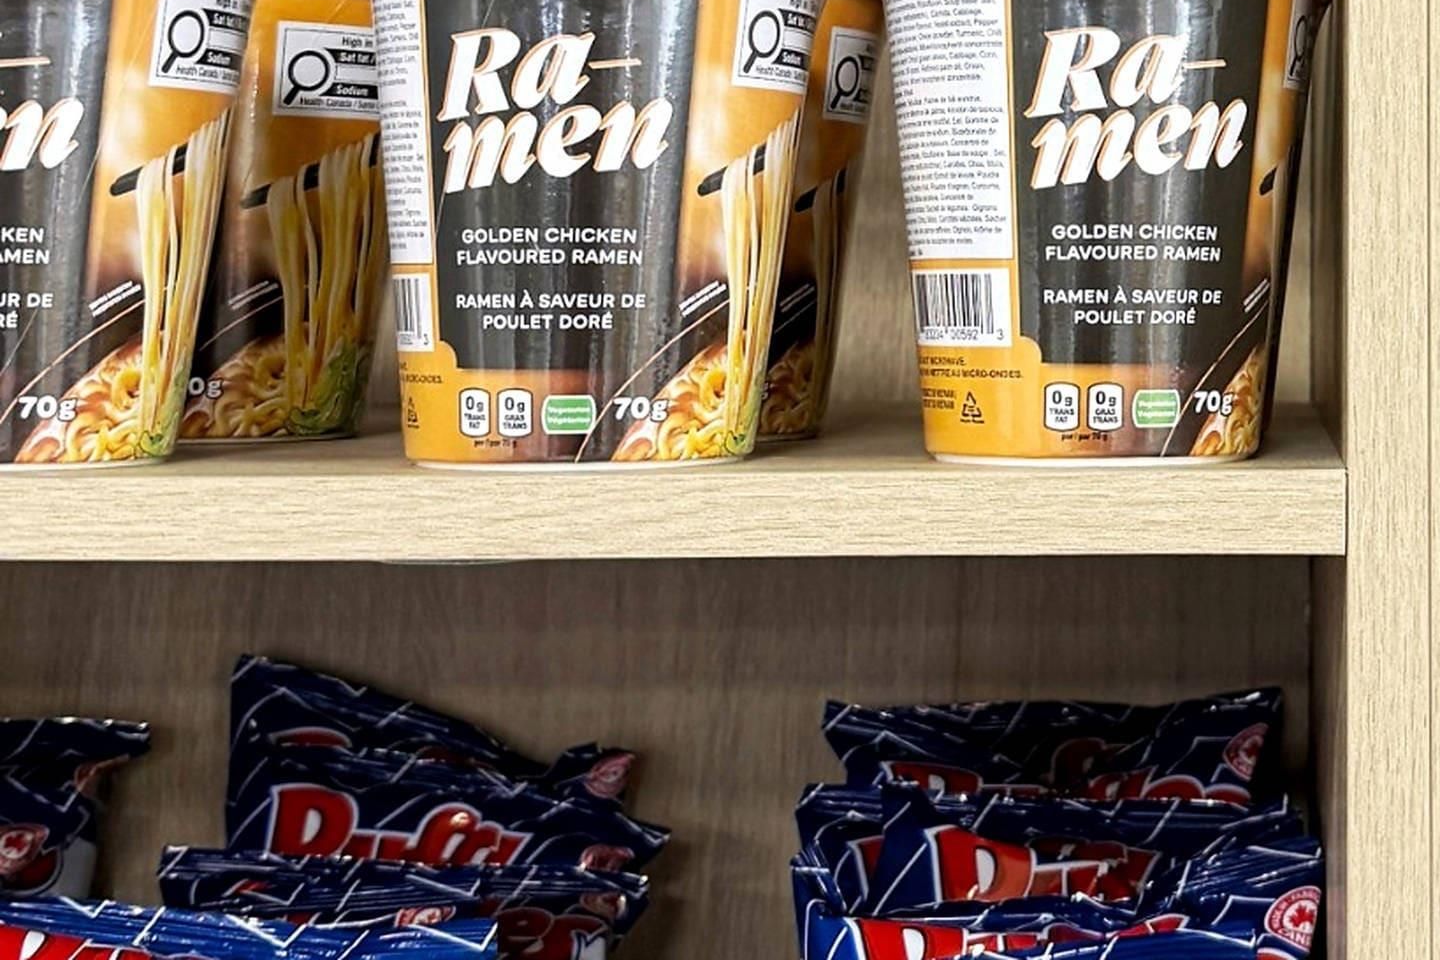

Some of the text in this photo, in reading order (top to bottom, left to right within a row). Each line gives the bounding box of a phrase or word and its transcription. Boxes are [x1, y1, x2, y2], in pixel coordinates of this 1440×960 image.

[461, 226, 637, 245] GOLDEN CHICKEN
[1051, 223, 1217, 241] GOLDEN CHICKEN
[456, 247, 643, 266] FLAVOURED RAMEN
[1045, 244, 1221, 262] FLAVOURED RAMEN
[26, 293, 53, 308] DE
[456, 287, 645, 309] RAMEN À SAVEUR DE
[1044, 284, 1222, 305] RAMEN À SAVEUR DE
[483, 309, 613, 330] POULET DORÉ
[1074, 305, 1196, 325] POULET DORÉ
[18, 395, 78, 421] 70g
[614, 396, 669, 422] 70g
[1193, 390, 1233, 416] 70g
